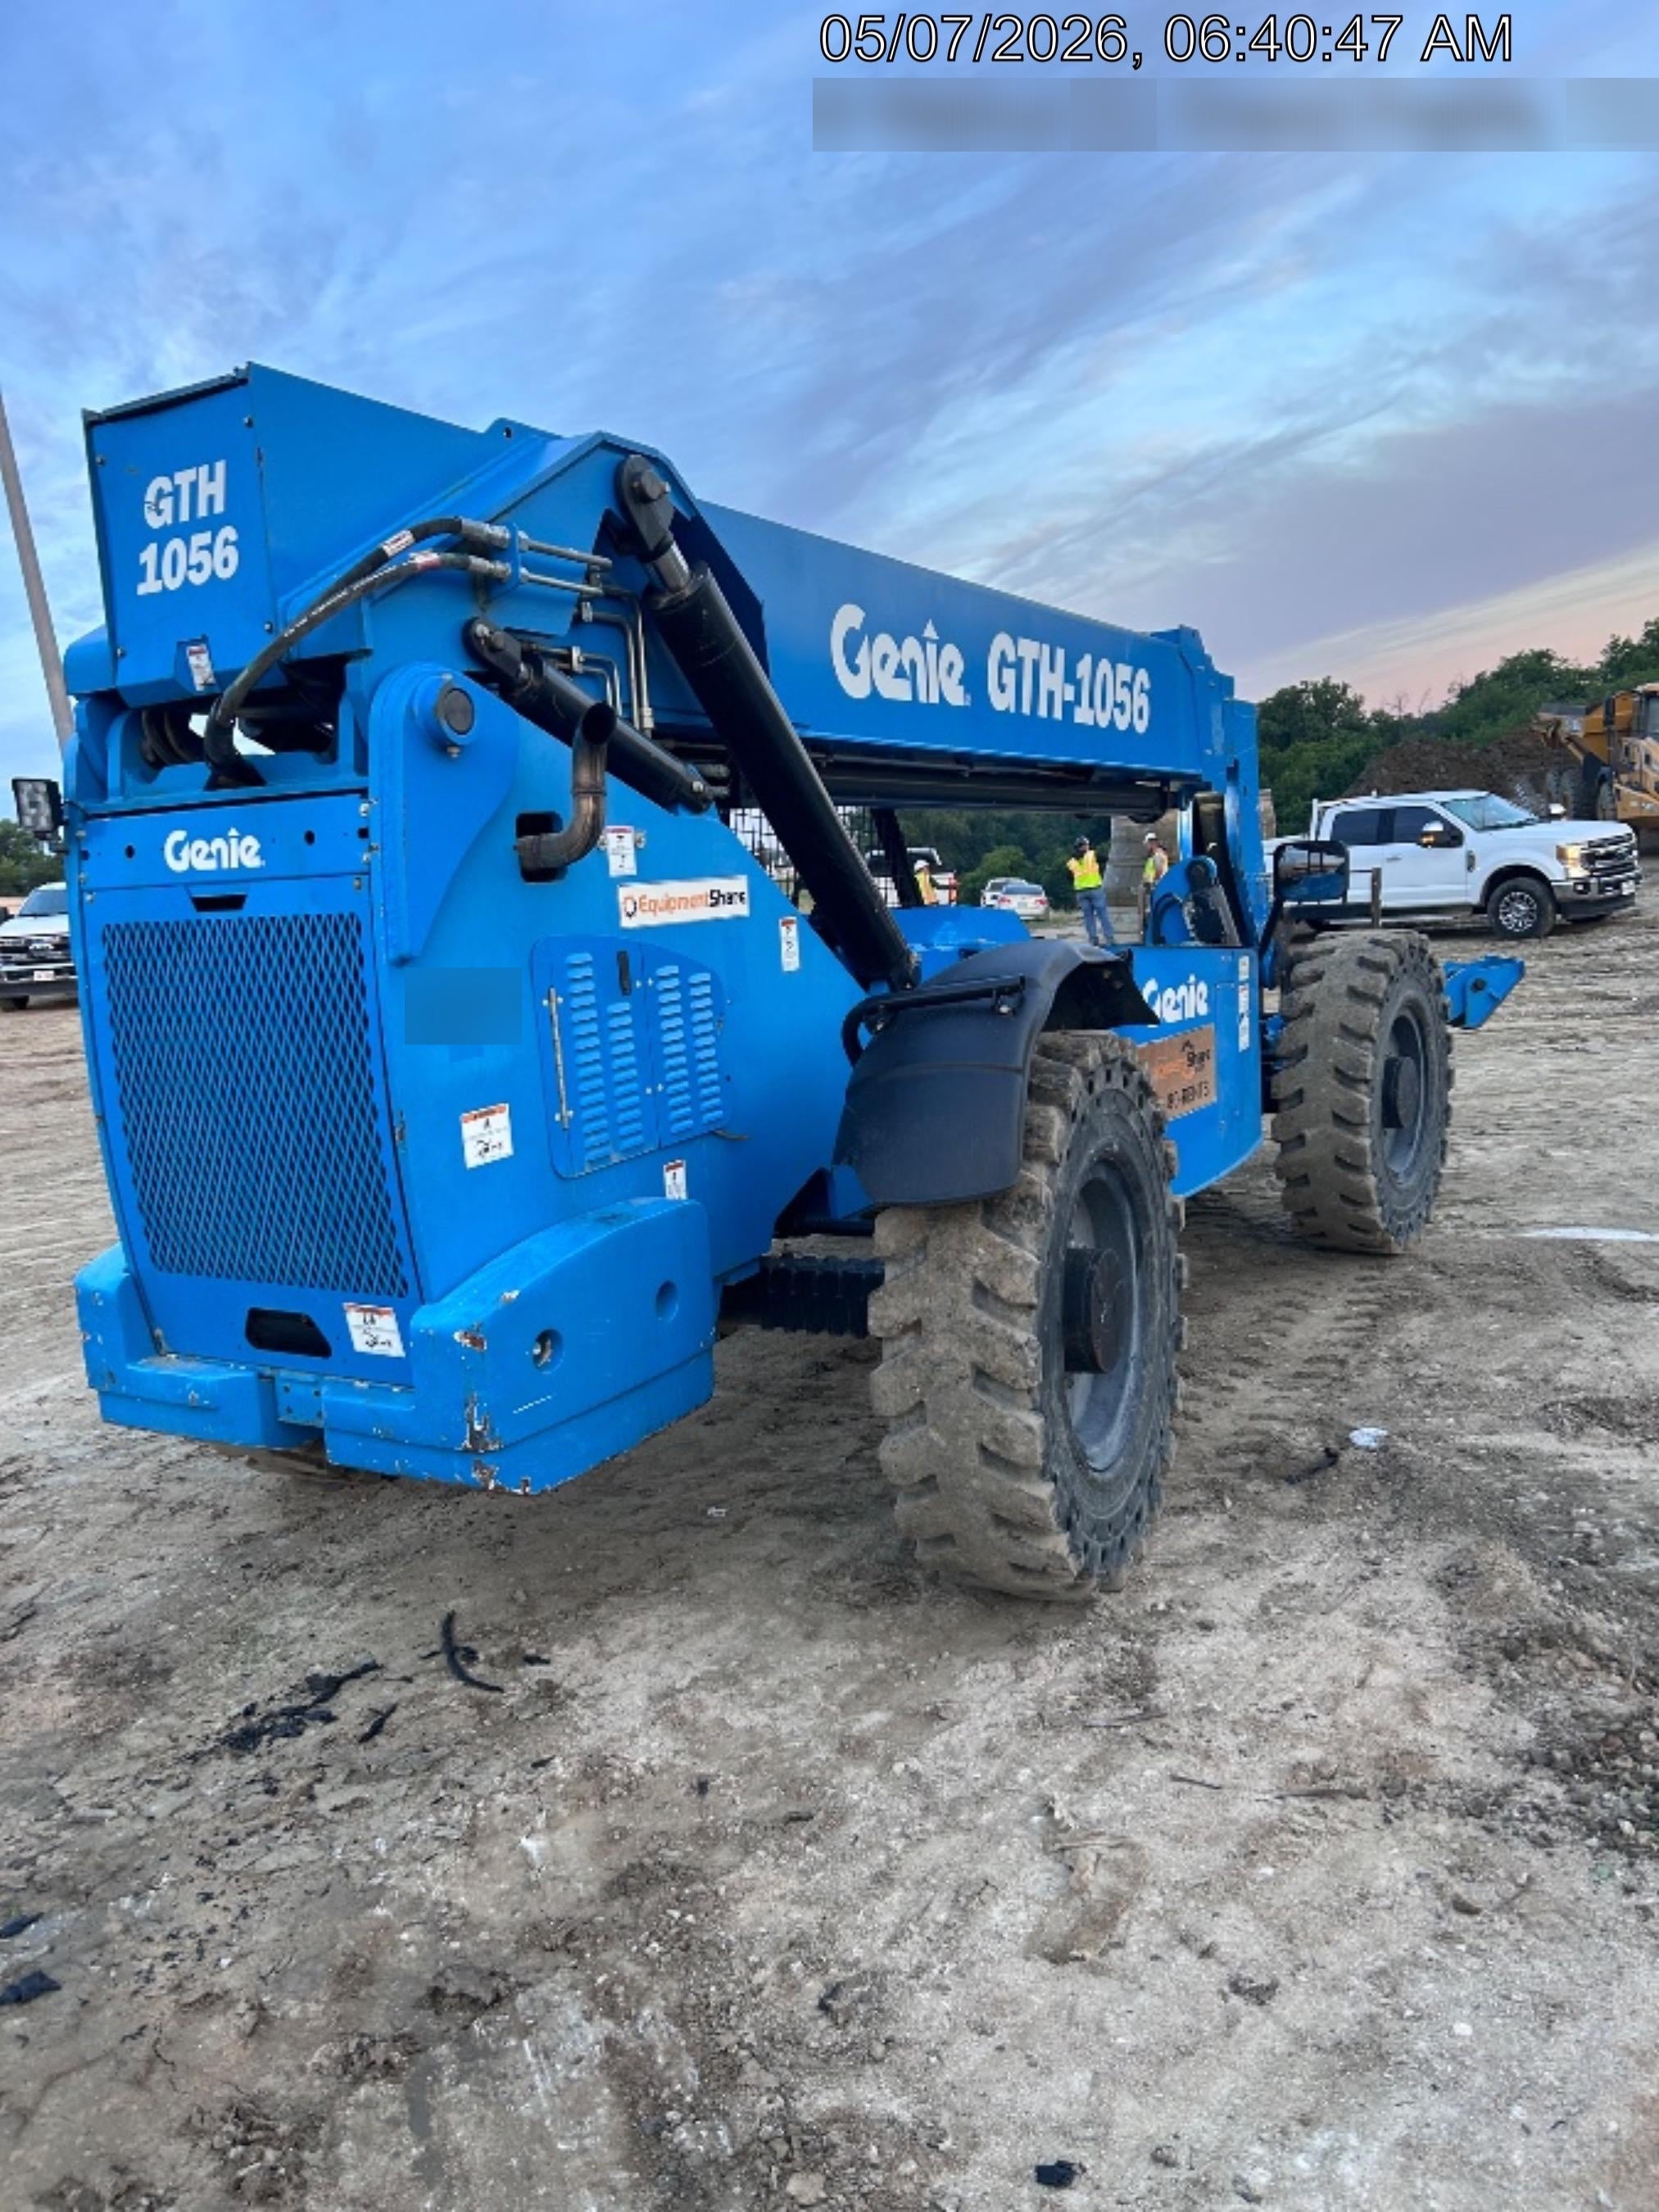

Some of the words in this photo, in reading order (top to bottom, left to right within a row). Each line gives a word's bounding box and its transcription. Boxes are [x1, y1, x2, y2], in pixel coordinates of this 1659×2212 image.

[144, 460, 226, 529] GTH
[137, 525, 238, 596] 1056
[831, 604, 966, 707] Genie
[988, 632, 1151, 734] GTH-1056
[164, 827, 261, 873] Genie
[638, 889, 746, 918] EquipmentShare
